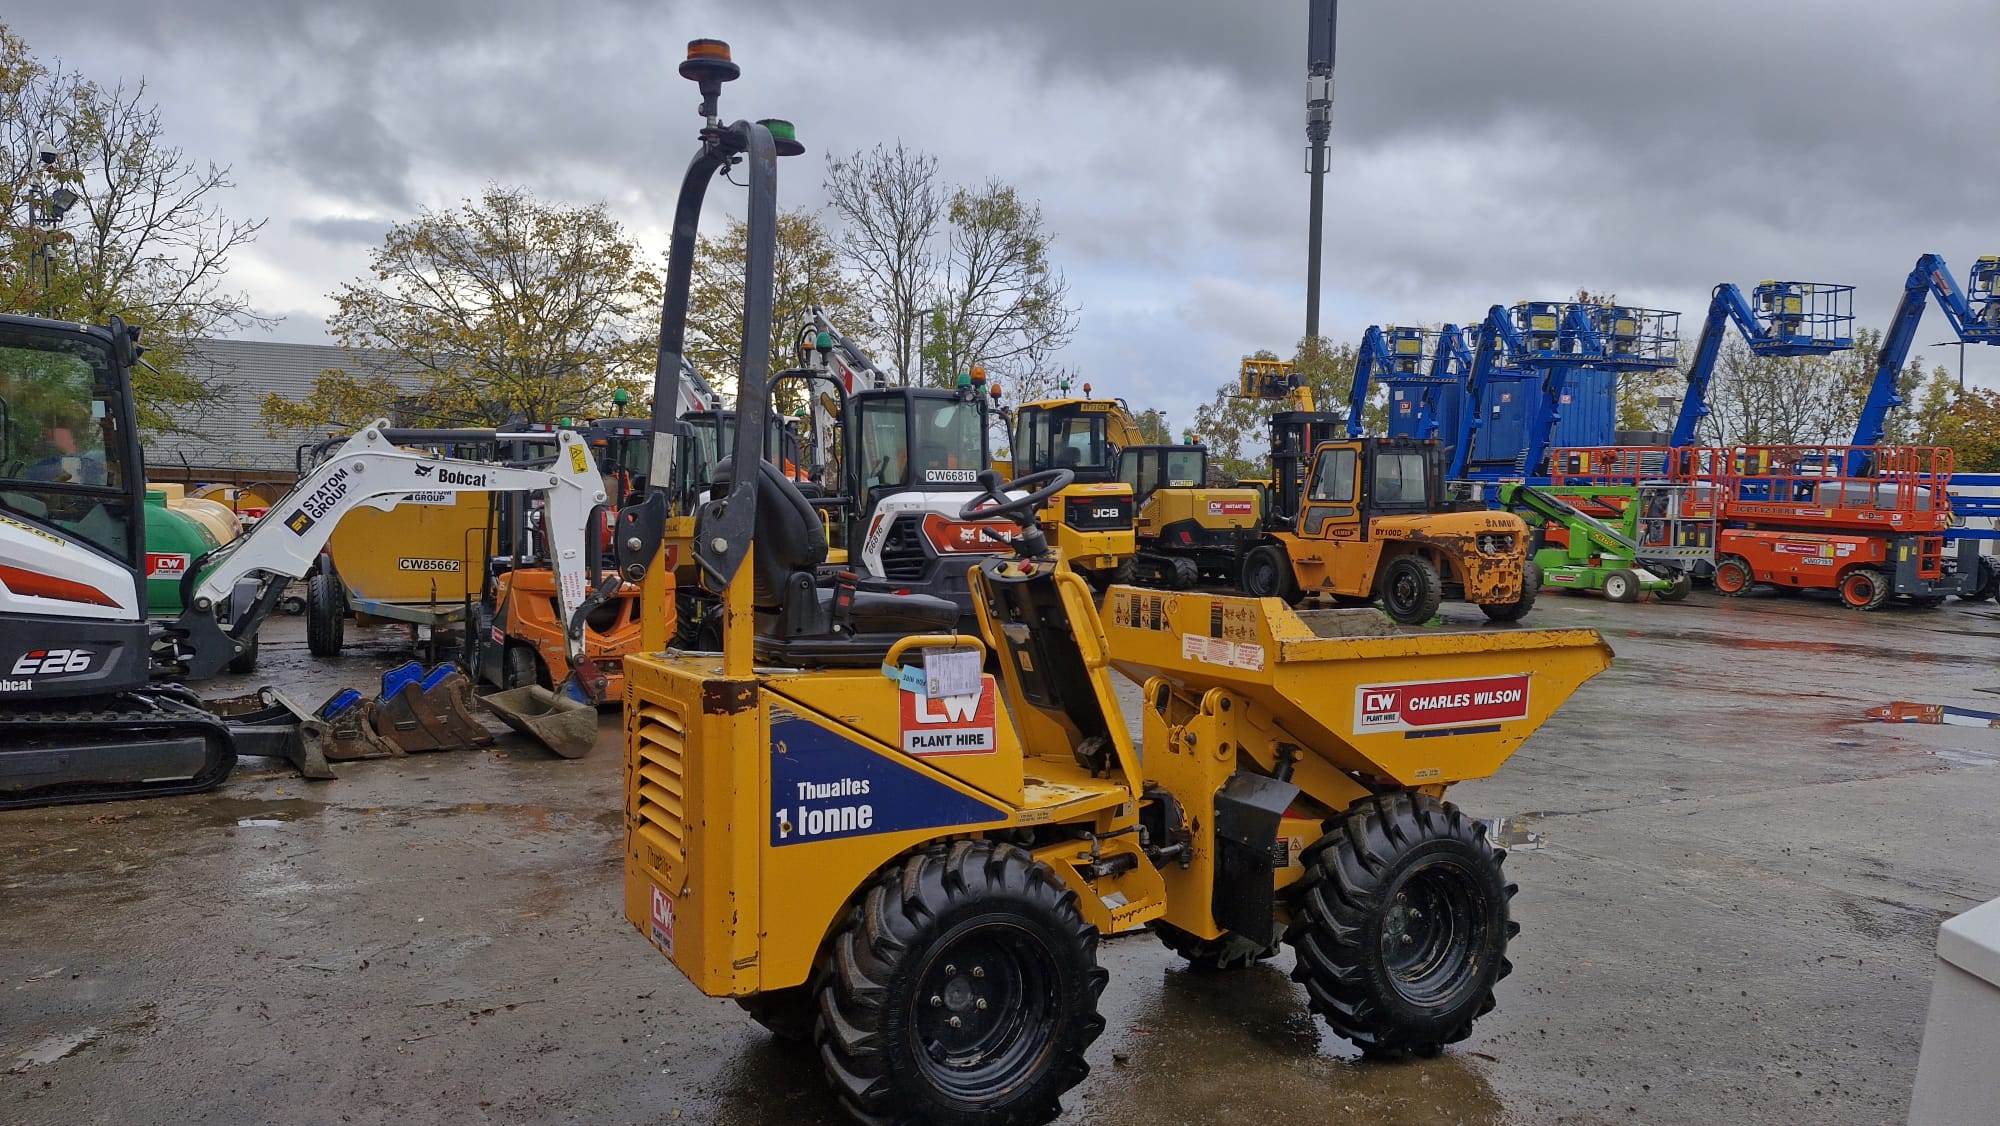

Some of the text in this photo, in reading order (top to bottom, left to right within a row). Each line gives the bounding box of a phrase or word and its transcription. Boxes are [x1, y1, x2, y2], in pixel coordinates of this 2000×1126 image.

[439, 468, 487, 487] Bobcat
[927, 471, 975, 481] CW66816
[303, 468, 348, 511] STATOM
[414, 494, 445, 502] GROUP
[311, 483, 347, 519] GROUP
[1092, 508, 1119, 518] JCB
[158, 558, 180, 569] CW
[400, 559, 459, 571] CW85662
[11, 648, 96, 675] E26
[1366, 689, 1522, 712] CW CHARLES WILSON
[1366, 713, 1396, 722] PLANT HIRE
[912, 733, 985, 748] PLANT HIRE
[797, 777, 870, 801] Thwaites
[776, 804, 873, 839] 1 tonne
[653, 887, 673, 929] CW
